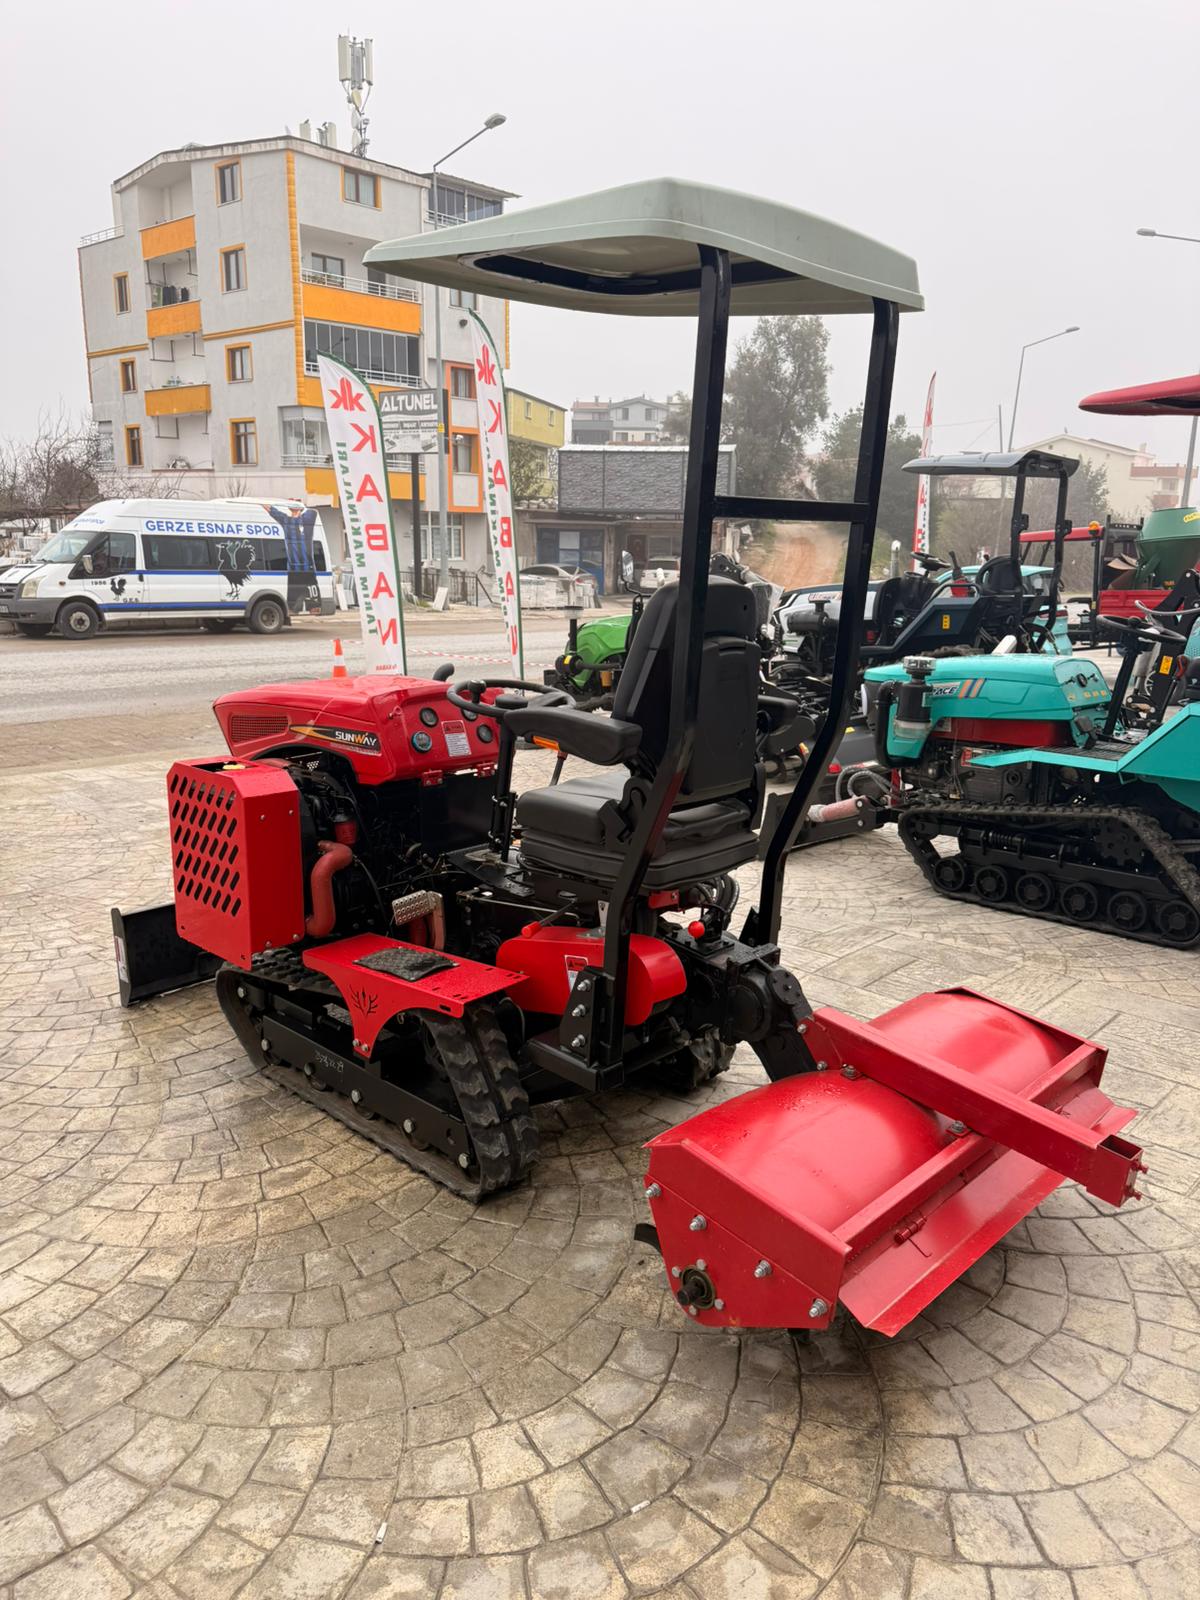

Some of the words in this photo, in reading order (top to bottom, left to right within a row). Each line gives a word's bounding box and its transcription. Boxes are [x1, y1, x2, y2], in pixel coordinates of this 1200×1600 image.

[381, 393, 438, 411] ALTUNEL
[145, 520, 194, 533] GERZE
[197, 522, 243, 535] ESNAF
[246, 524, 280, 536] SPOR
[307, 584, 318, 598] 10
[335, 731, 377, 746] SUNWAY
